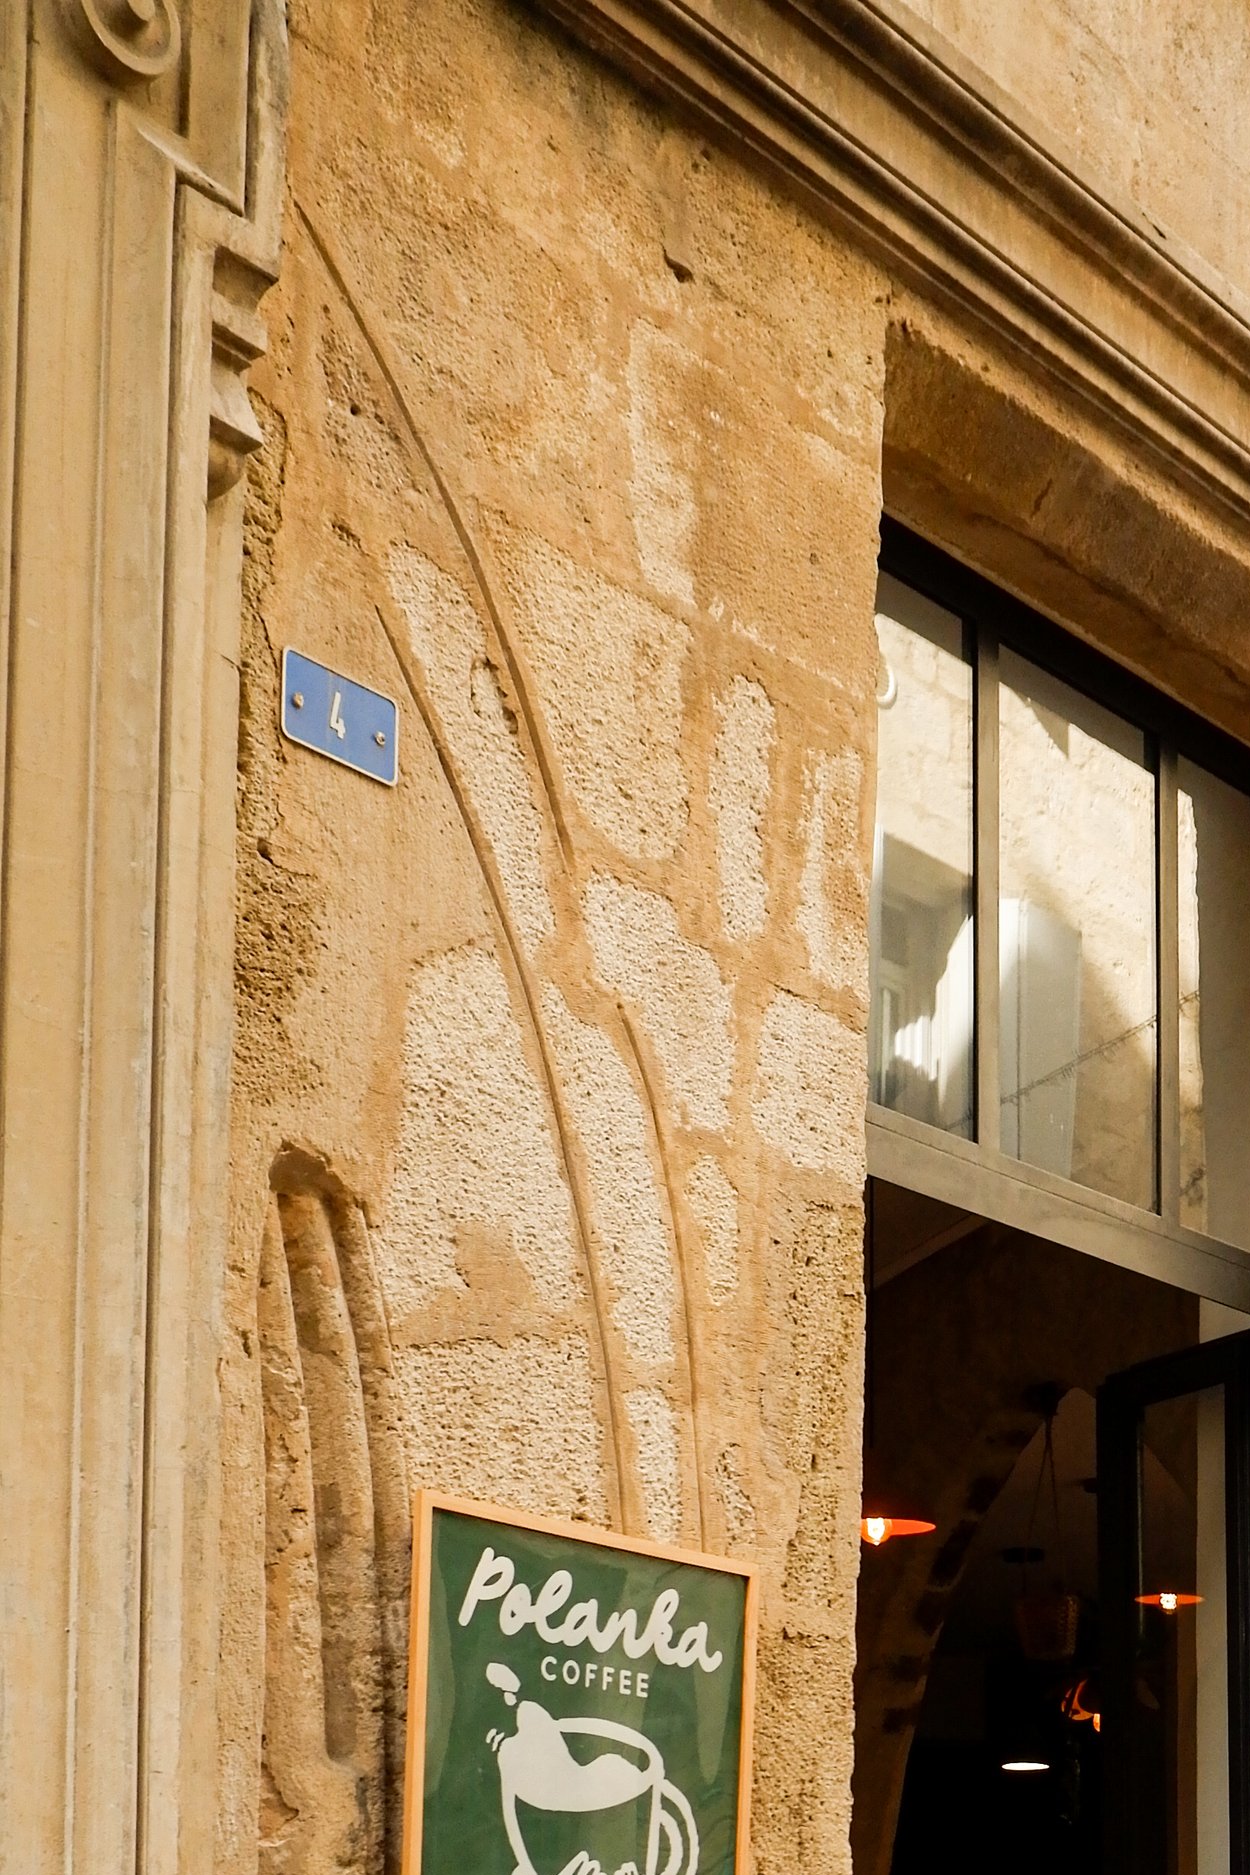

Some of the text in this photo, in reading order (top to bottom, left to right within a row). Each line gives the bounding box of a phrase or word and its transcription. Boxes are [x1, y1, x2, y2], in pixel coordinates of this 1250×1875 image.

[330, 691, 346, 739] 4
[458, 1546, 723, 1673] Polanka
[540, 1655, 649, 1698] COFFEE
